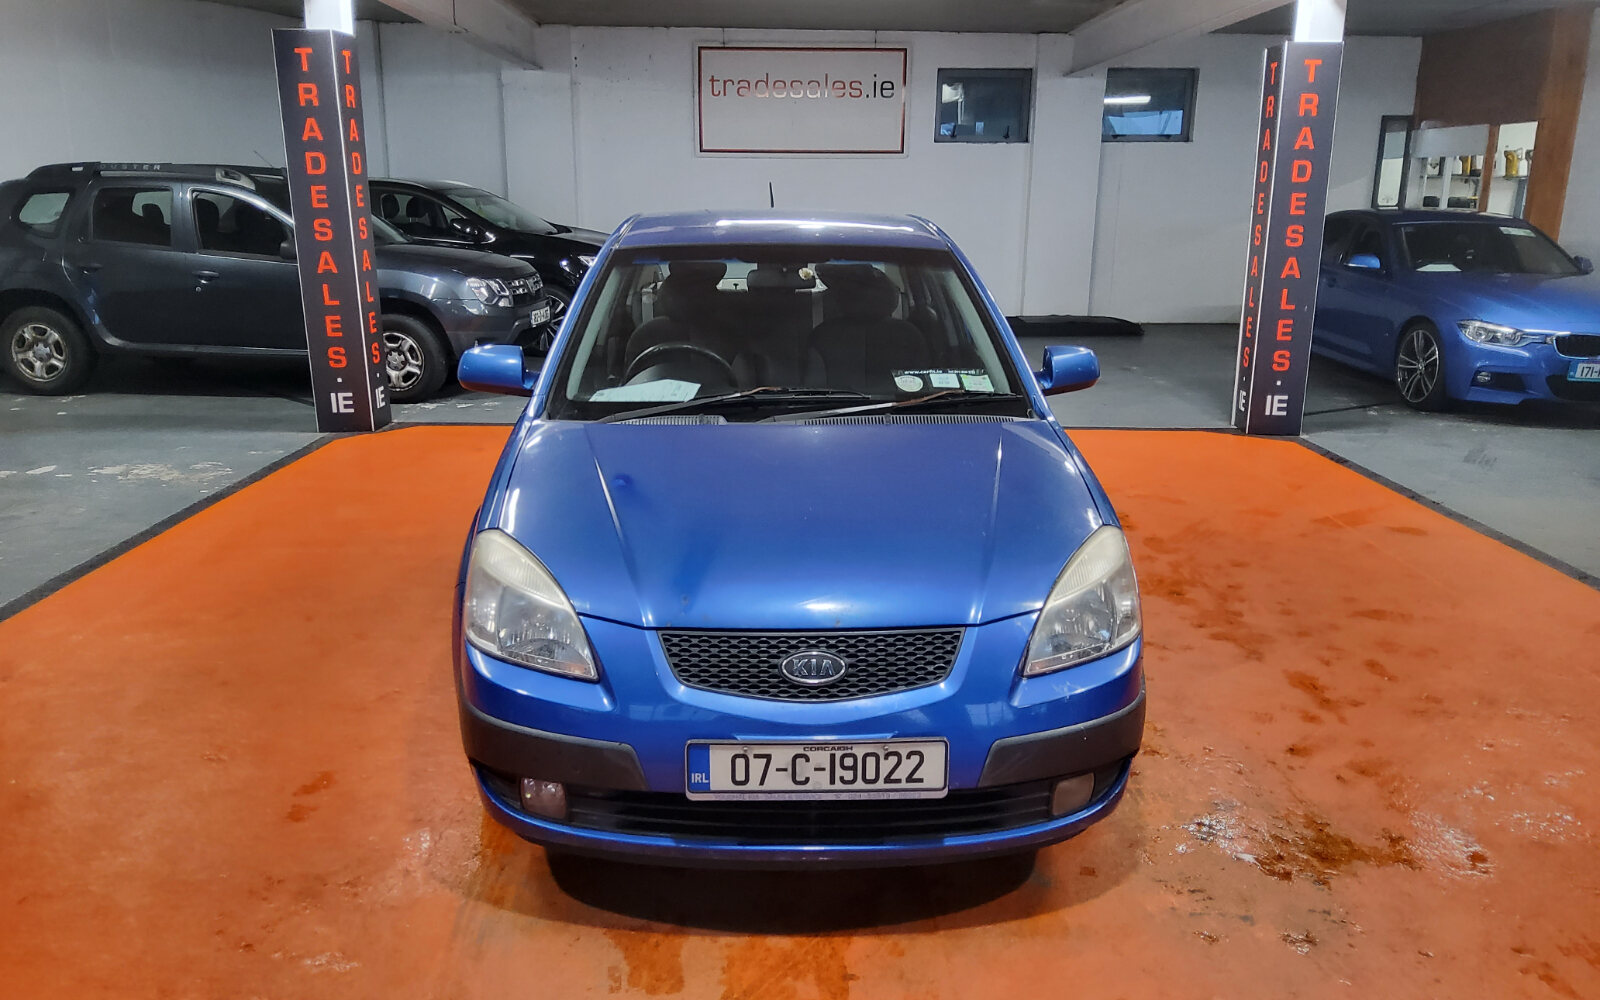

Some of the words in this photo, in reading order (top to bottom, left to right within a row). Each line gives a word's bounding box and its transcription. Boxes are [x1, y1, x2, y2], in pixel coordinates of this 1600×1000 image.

[708, 72, 895, 99] tradesales.ie
[1580, 366, 1600, 378] 171-
[792, 658, 836, 676] KIA
[730, 750, 925, 786] 07-C-19022
[691, 772, 709, 784] IRL
